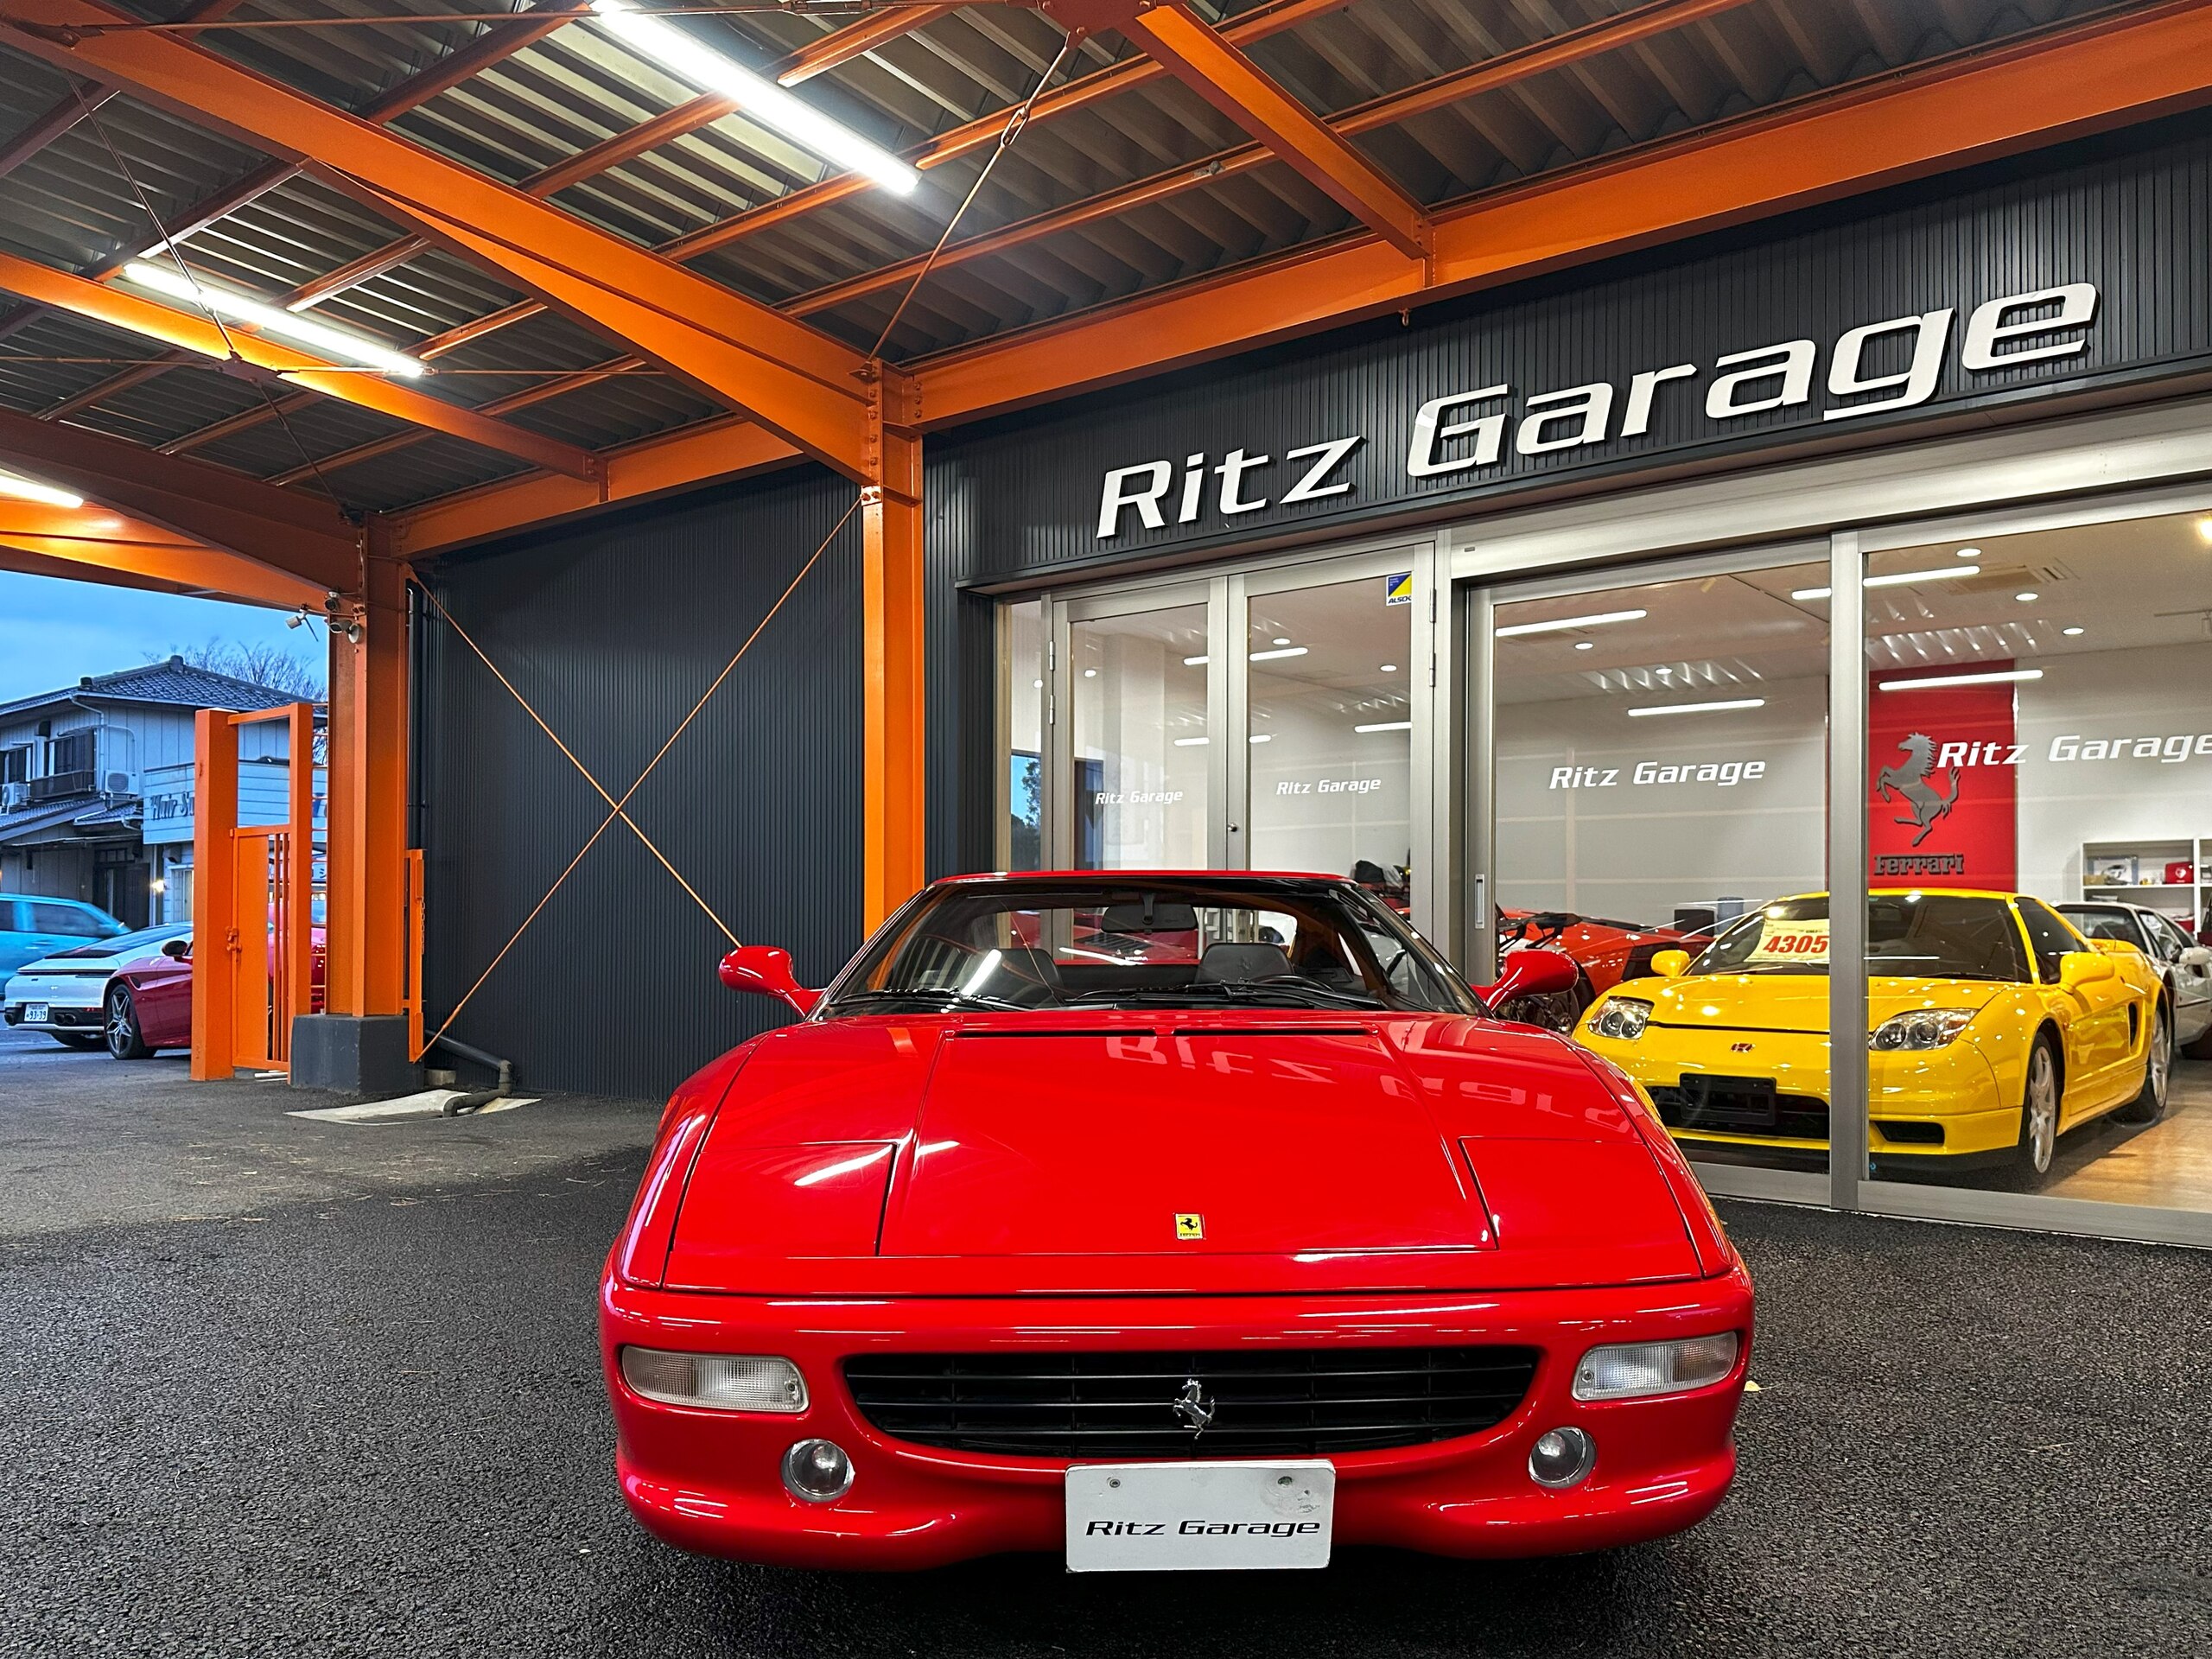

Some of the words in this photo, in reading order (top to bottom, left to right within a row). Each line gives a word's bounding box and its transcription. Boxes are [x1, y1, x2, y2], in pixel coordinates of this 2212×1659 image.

[1096, 435, 1364, 538] Ritz
[1407, 281, 2099, 478] Garage
[1936, 741, 2030, 767] Ritz
[1549, 766, 1619, 789] Ritz
[1633, 760, 1766, 786] Garage
[1095, 792, 1124, 804] Ritz
[1129, 791, 1183, 804] Garage
[1275, 781, 1311, 795] Ritz
[1318, 779, 1381, 794] Garage
[150, 793, 178, 820] Hair
[1874, 853, 1963, 875] Ferrari
[1763, 935, 1829, 953] 4305
[1086, 1521, 1166, 1535] Ritz
[1179, 1520, 1320, 1537] Garage
